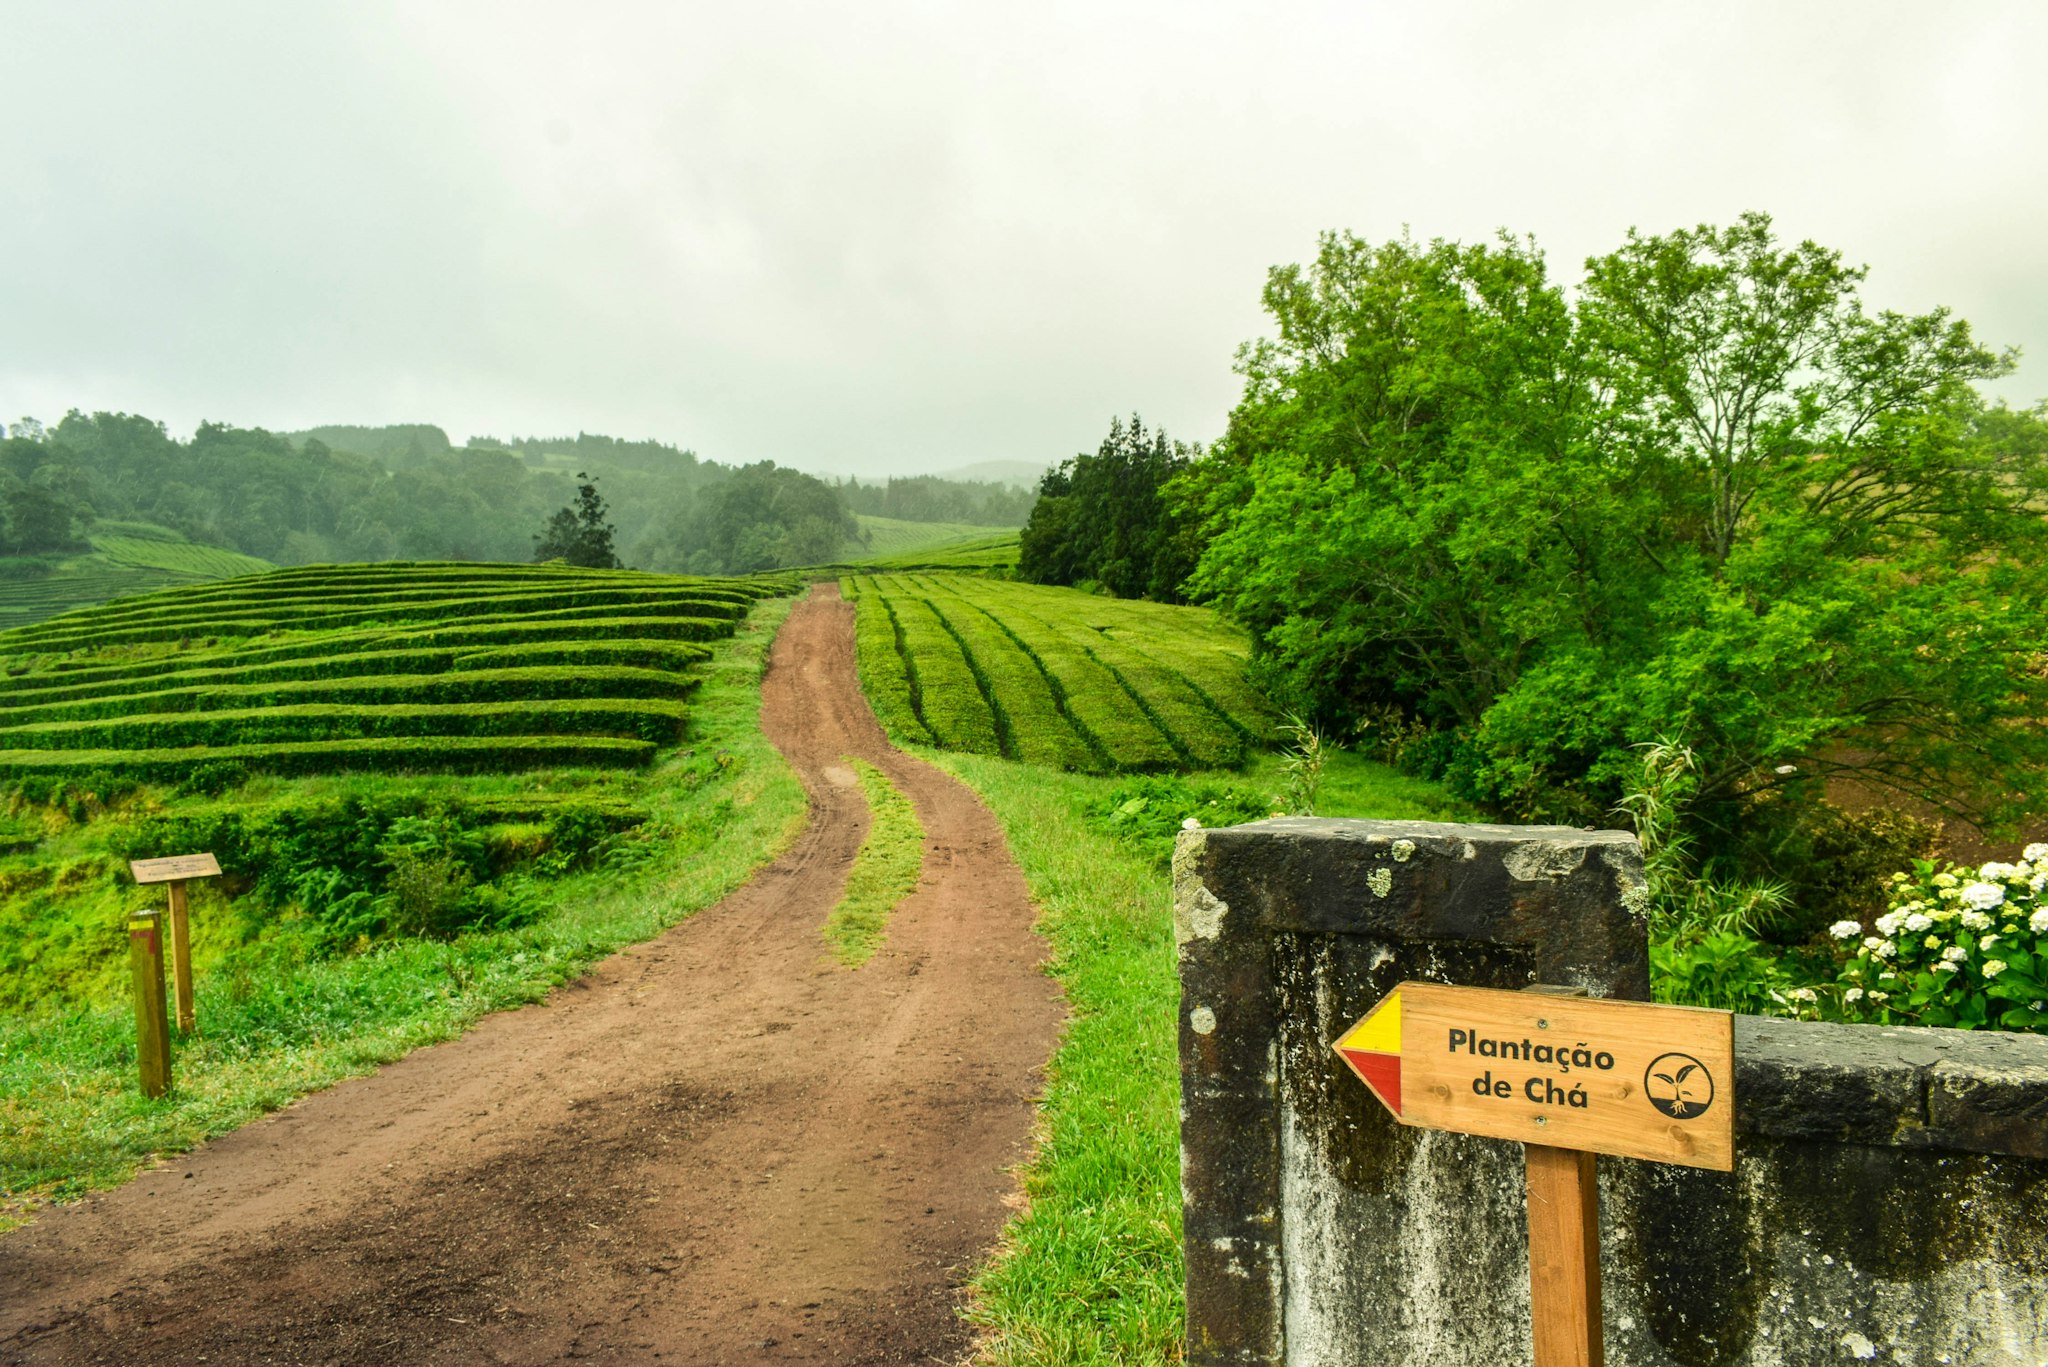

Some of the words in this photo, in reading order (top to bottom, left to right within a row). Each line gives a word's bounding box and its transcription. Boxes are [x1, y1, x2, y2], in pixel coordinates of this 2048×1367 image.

[1449, 1028, 1615, 1073] Plantação
[1472, 1070, 1512, 1099] de
[1524, 1077, 1588, 1109] Chá
